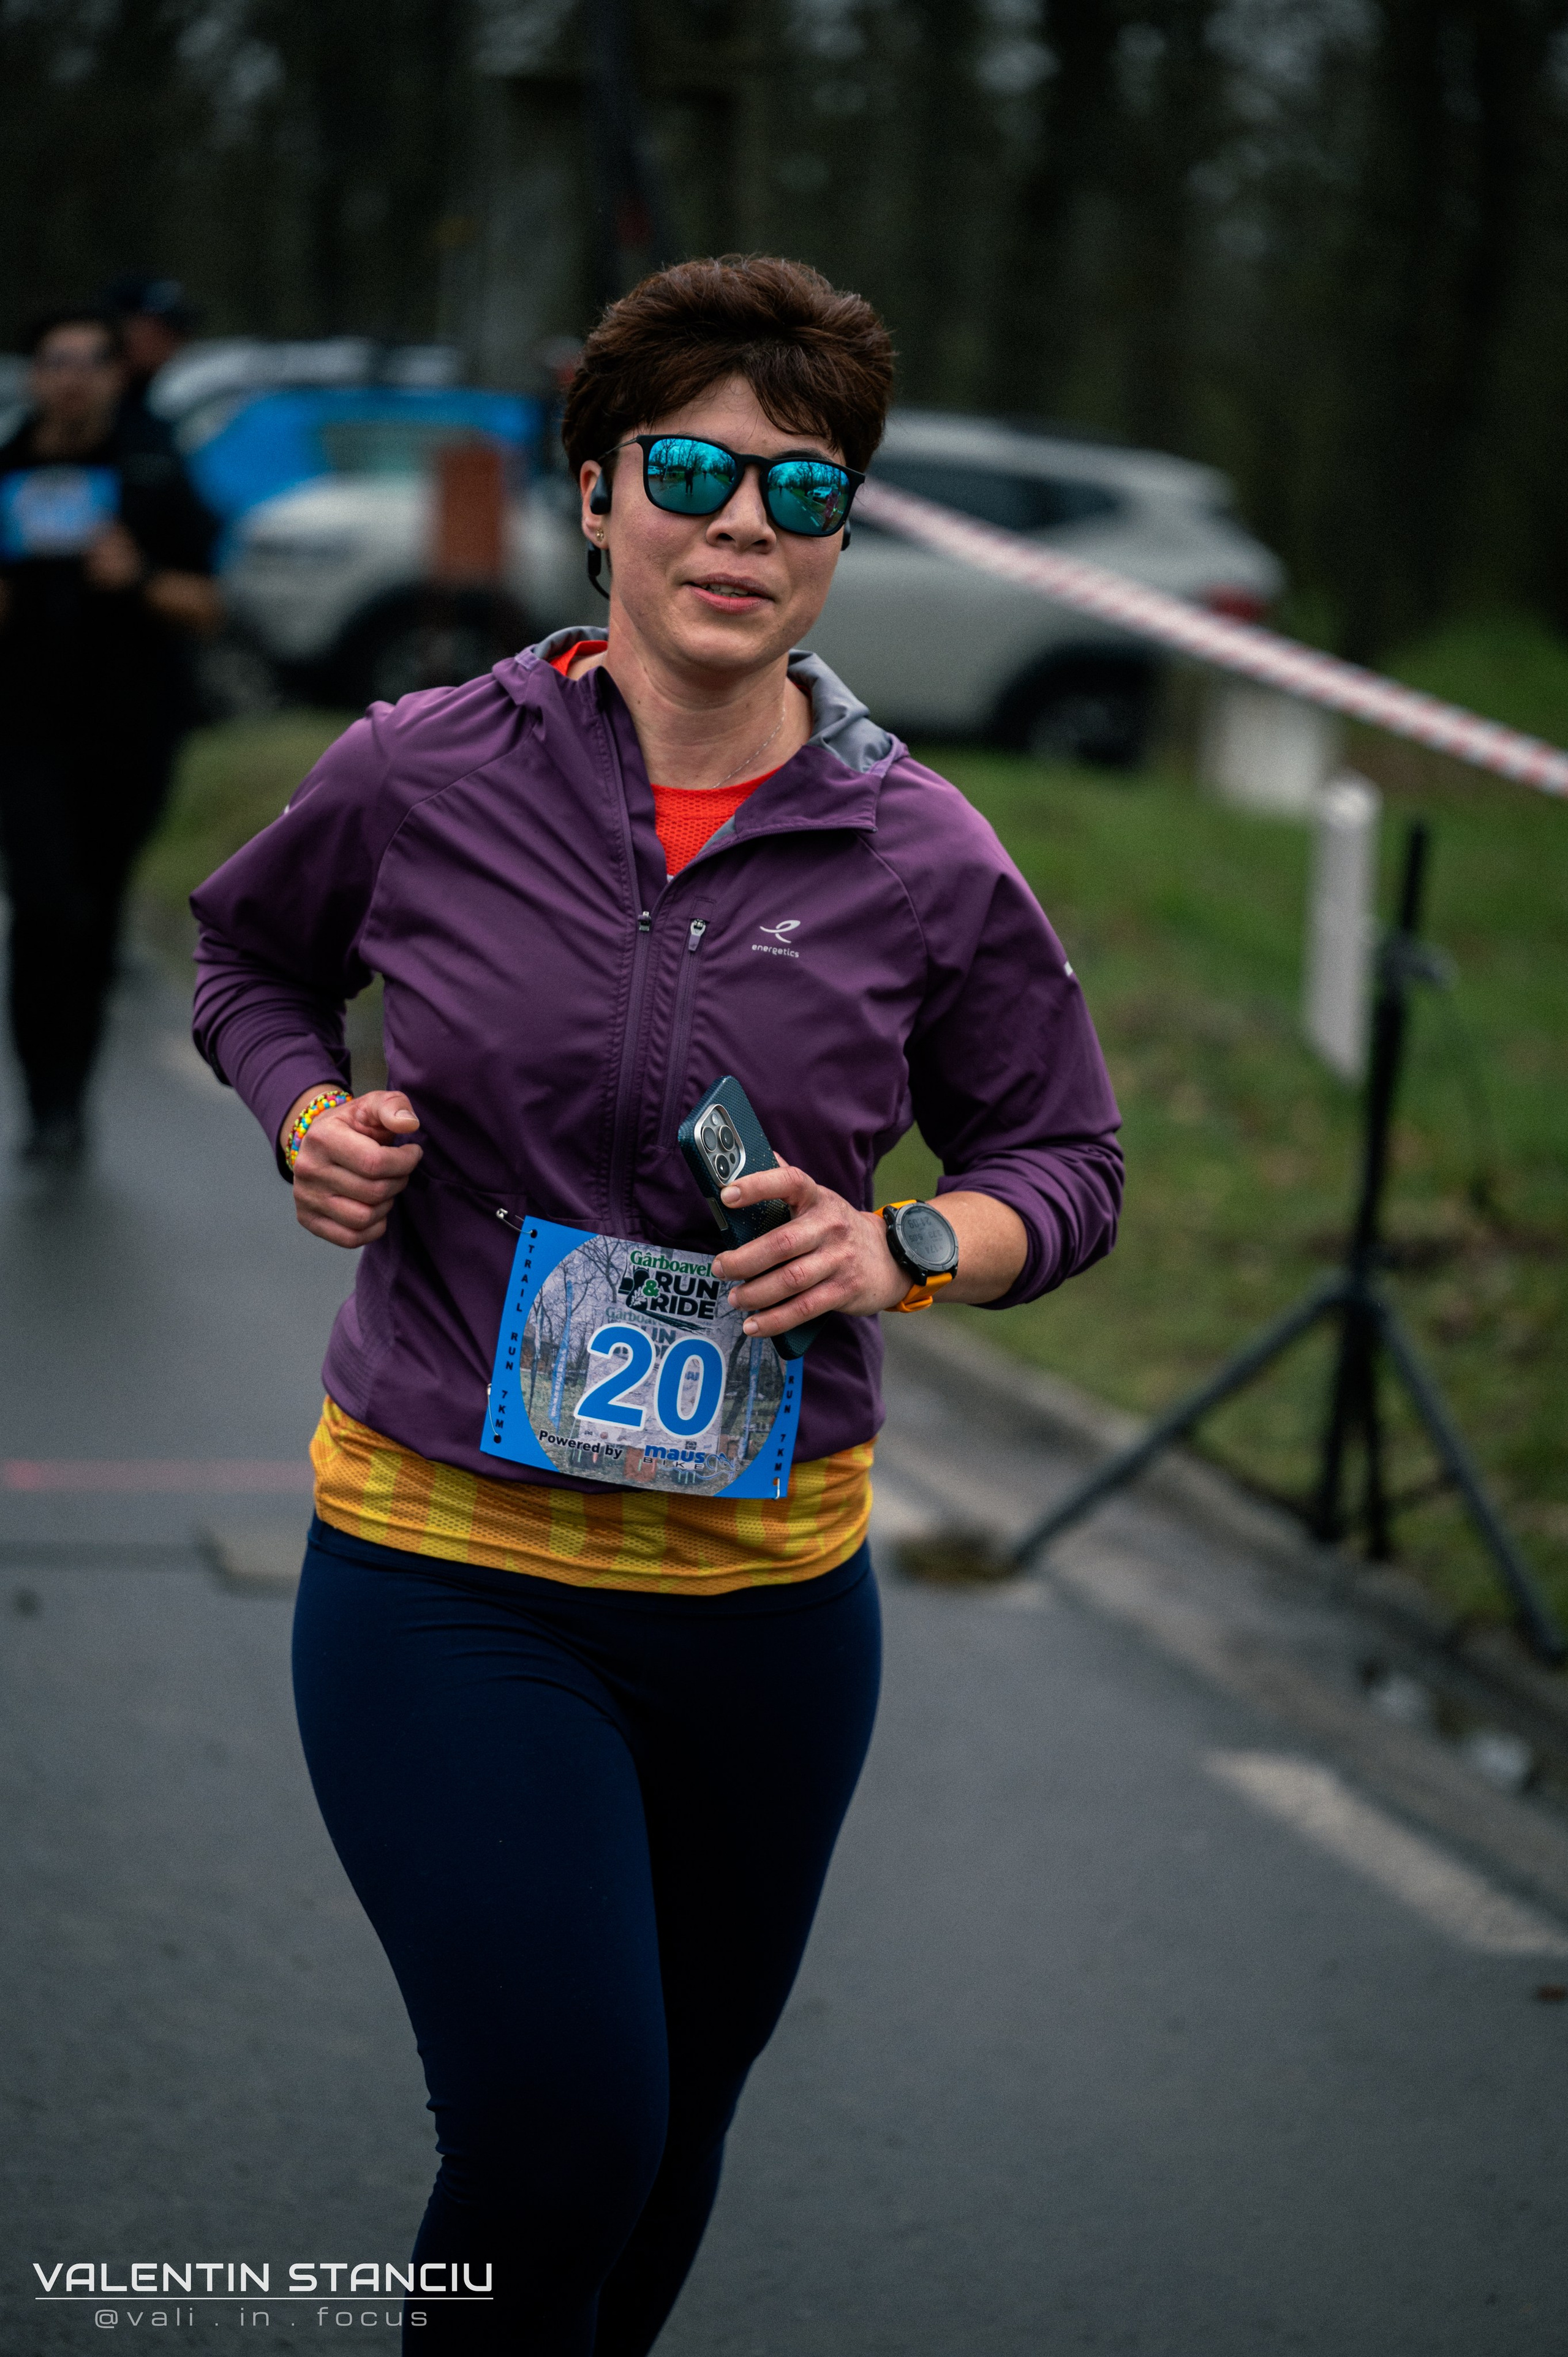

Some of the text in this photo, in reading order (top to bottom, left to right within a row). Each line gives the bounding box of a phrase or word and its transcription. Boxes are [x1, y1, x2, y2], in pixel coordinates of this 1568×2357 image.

[752, 944, 799, 958] energetics
[643, 1280, 659, 1297] &
[655, 1270, 720, 1300] RUN
[650, 1293, 716, 1320] RIDE
[505, 1332, 519, 1370] RUN
[575, 1323, 726, 1439] 20
[784, 1375, 794, 1414] RUN
[539, 1430, 623, 1459] Powered by
[644, 1444, 705, 1463] maus
[643, 1457, 704, 1469] BIKE
